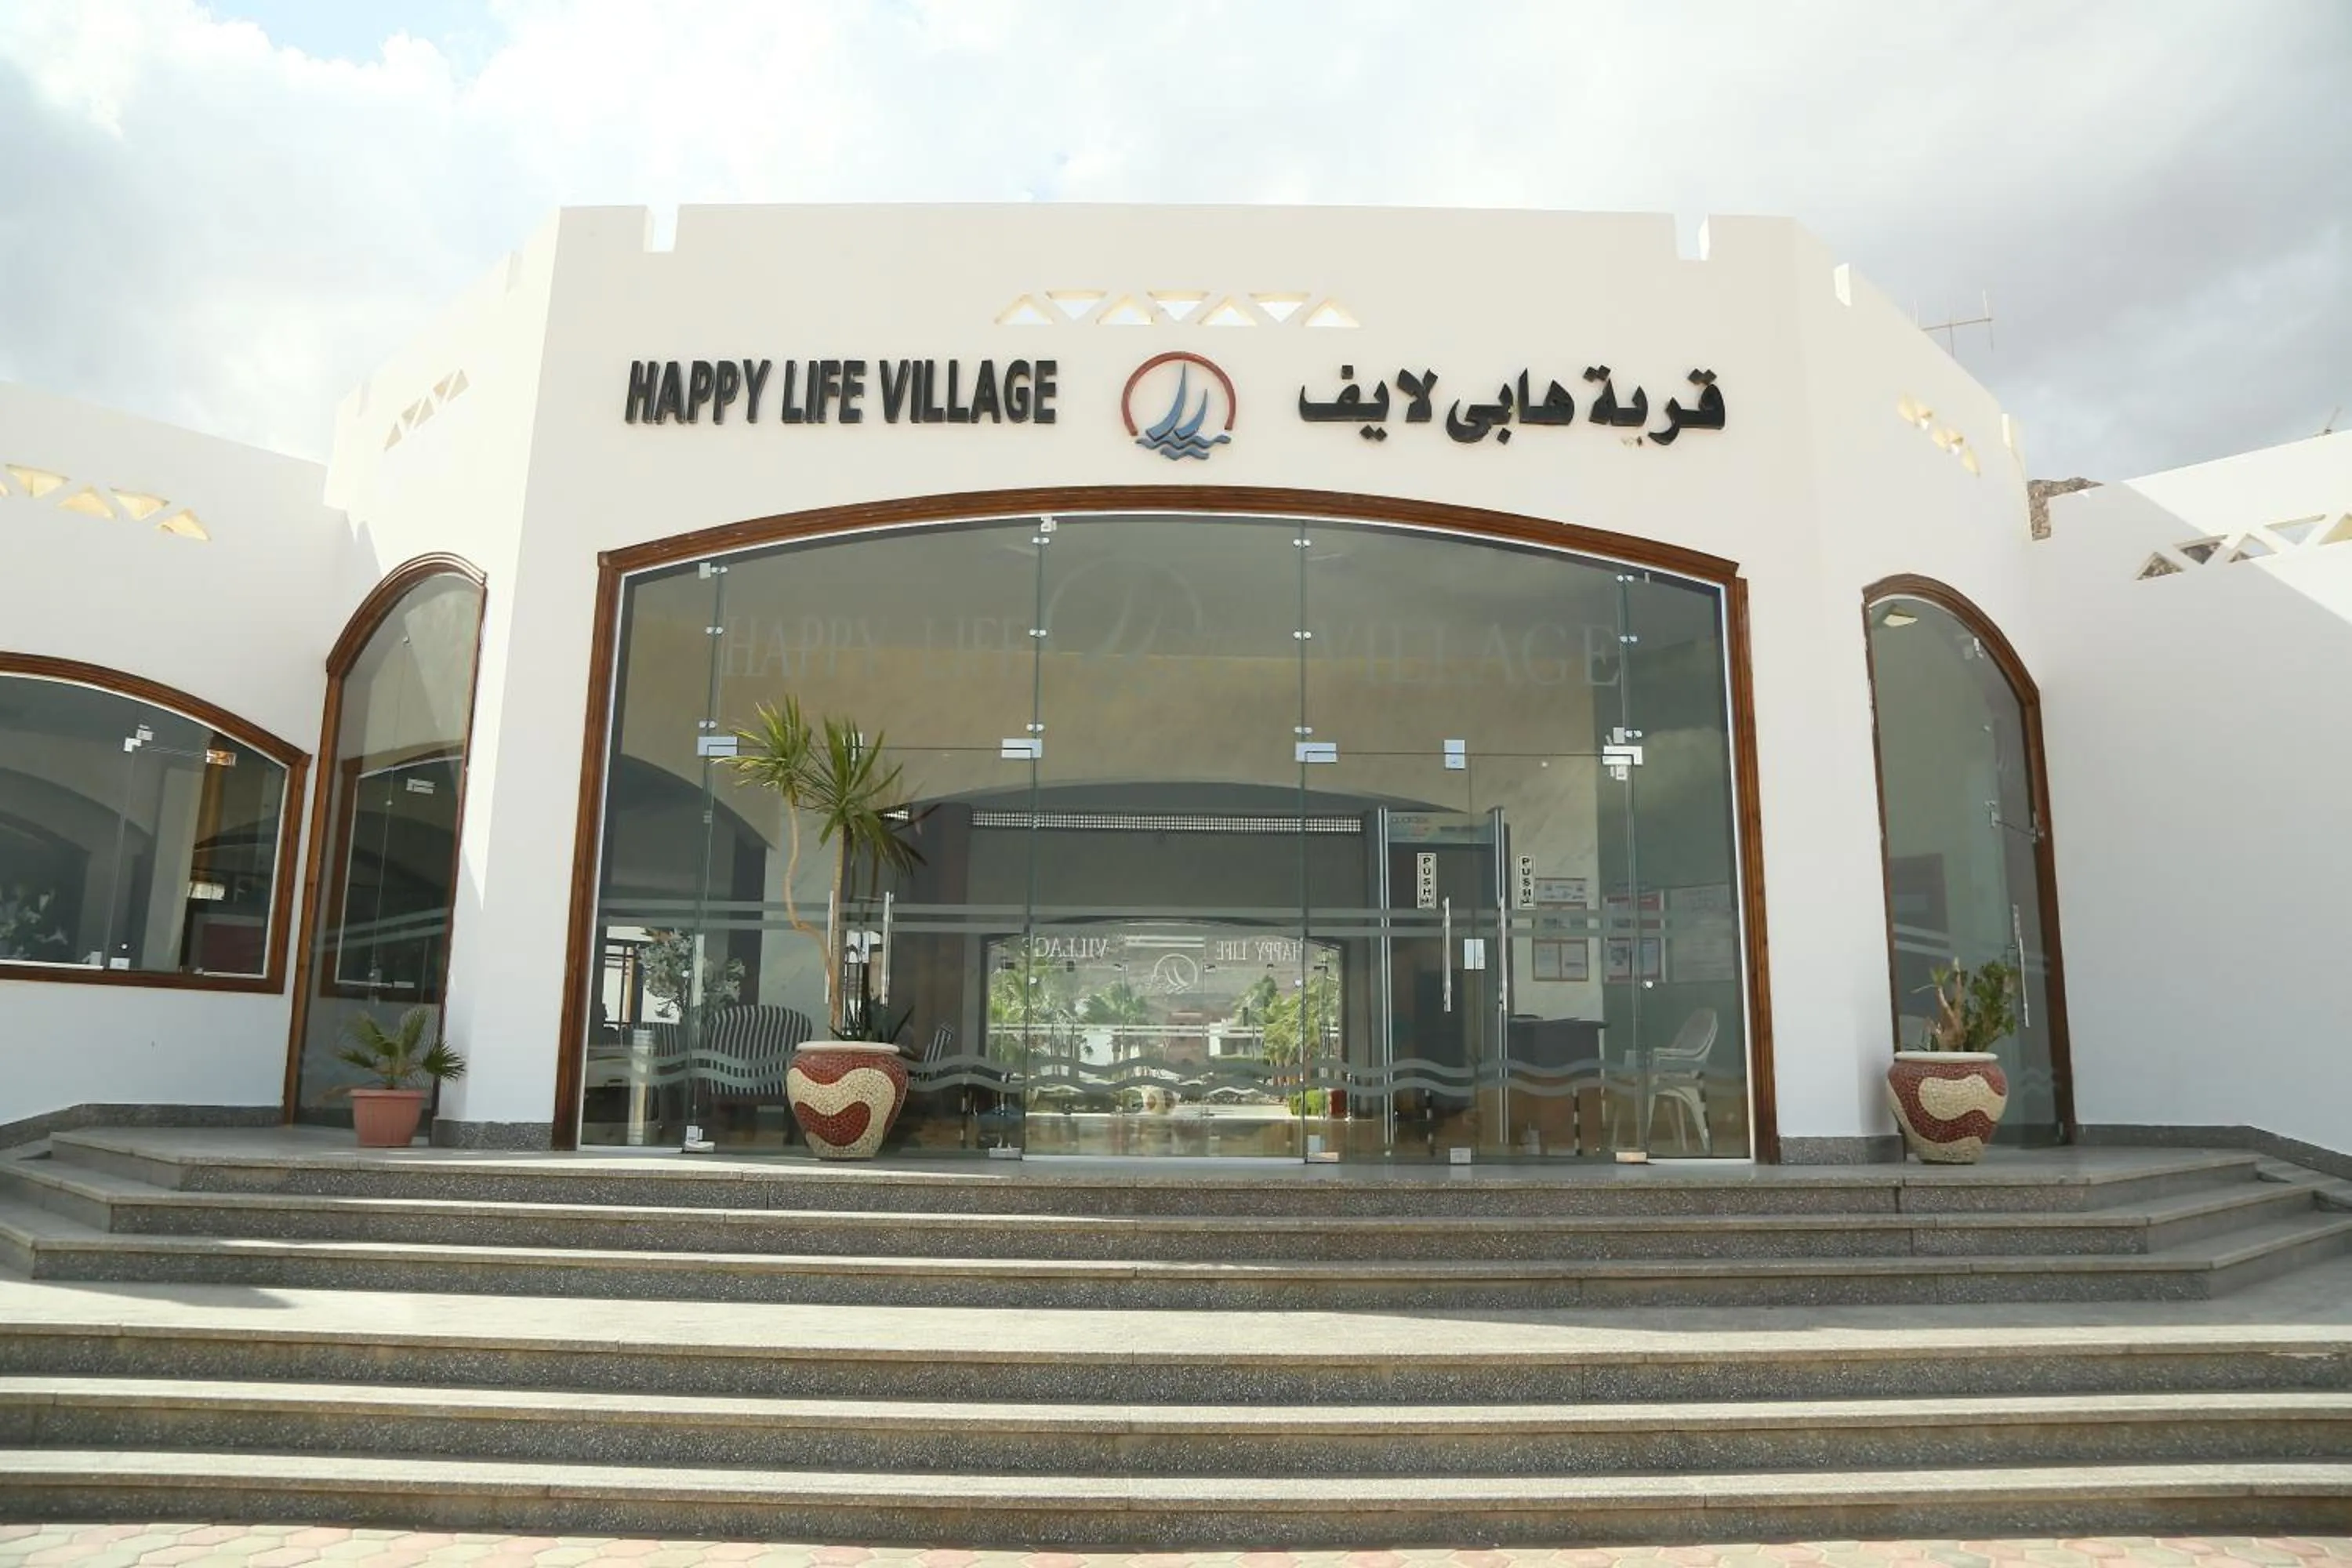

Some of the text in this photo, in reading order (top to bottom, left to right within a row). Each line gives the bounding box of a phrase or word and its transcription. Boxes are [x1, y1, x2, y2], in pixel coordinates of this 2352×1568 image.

[626, 359, 1058, 426] HAPPY LIFE VILLAGE
[1298, 365, 1439, 442] لايف
[724, 614, 889, 677] HAPPY
[1315, 619, 1621, 687] VILLAGE
[1422, 856, 1432, 896] PUSH
[1521, 856, 1531, 897] PUSH
